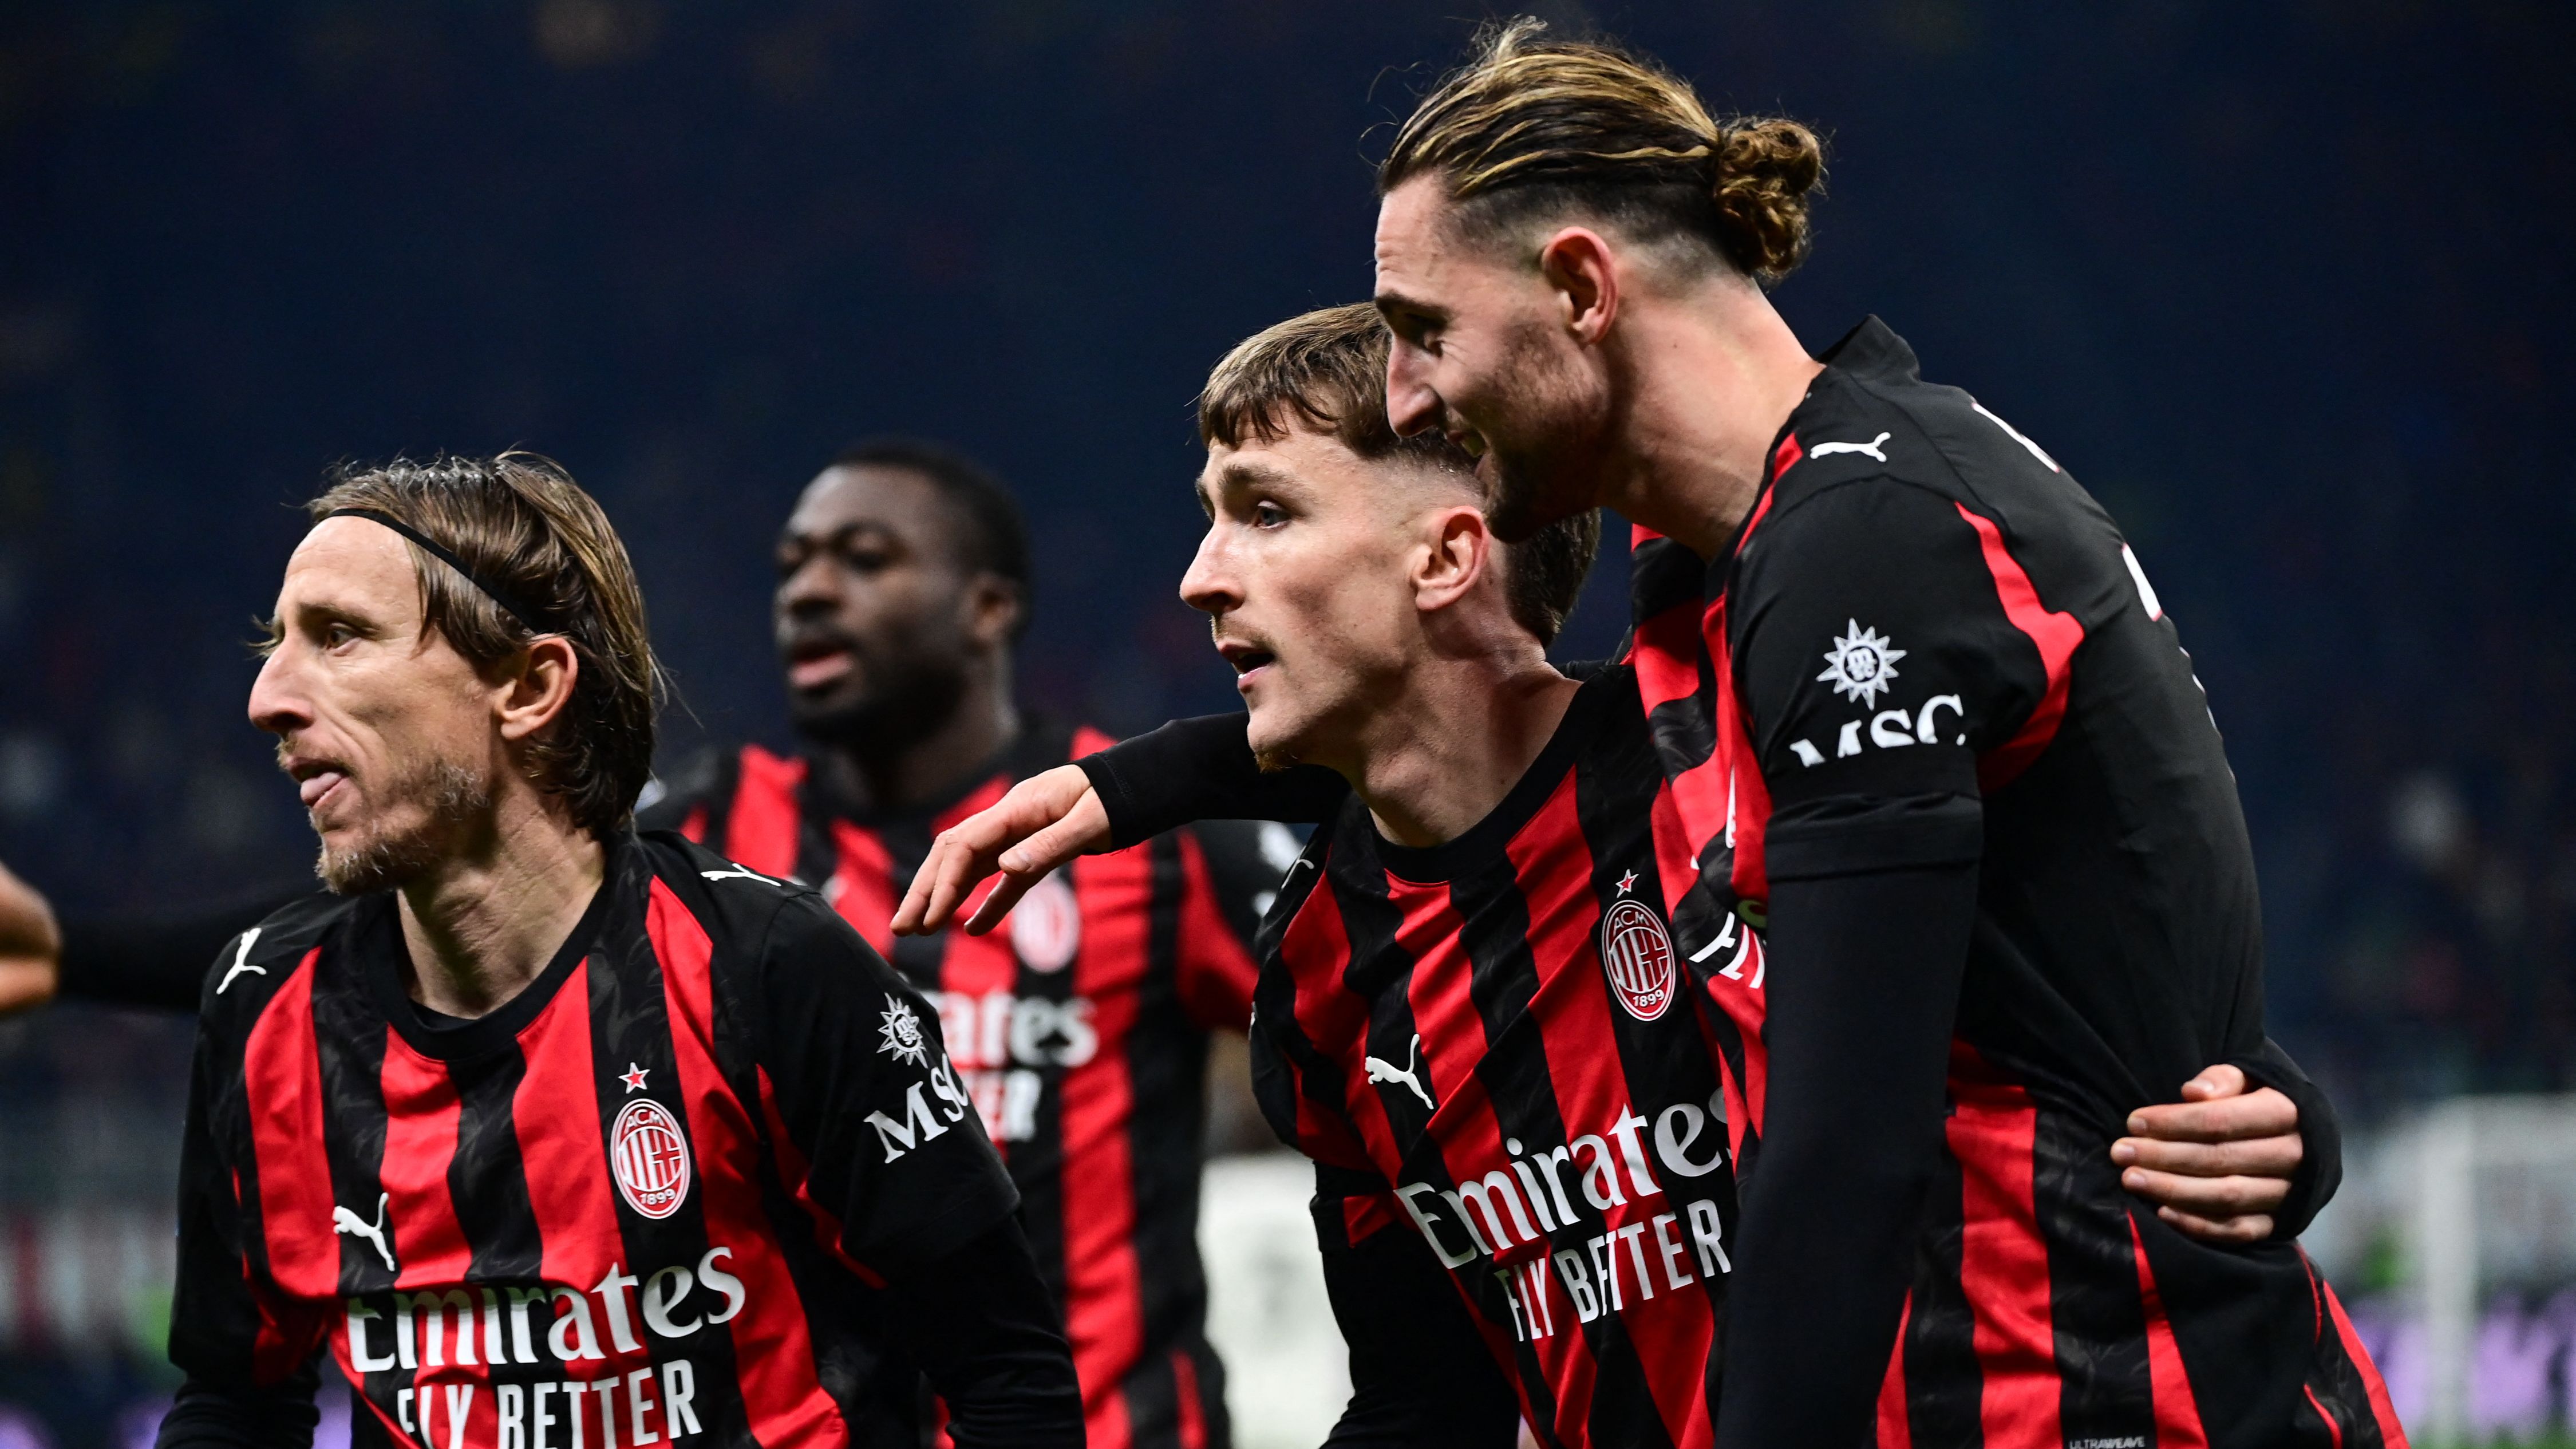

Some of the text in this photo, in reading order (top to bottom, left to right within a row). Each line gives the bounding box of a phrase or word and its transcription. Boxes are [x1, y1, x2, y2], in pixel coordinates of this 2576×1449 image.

[1613, 910, 1650, 937] ACM
[1633, 989, 1665, 1007] 1899
[624, 1109, 665, 1134] ACM
[863, 1053, 969, 1164] MSC
[639, 1189, 676, 1205] 1899
[347, 1246, 746, 1372] Emirates
[1494, 1258, 1554, 1341] FLY
[497, 1359, 702, 1448] BETTER
